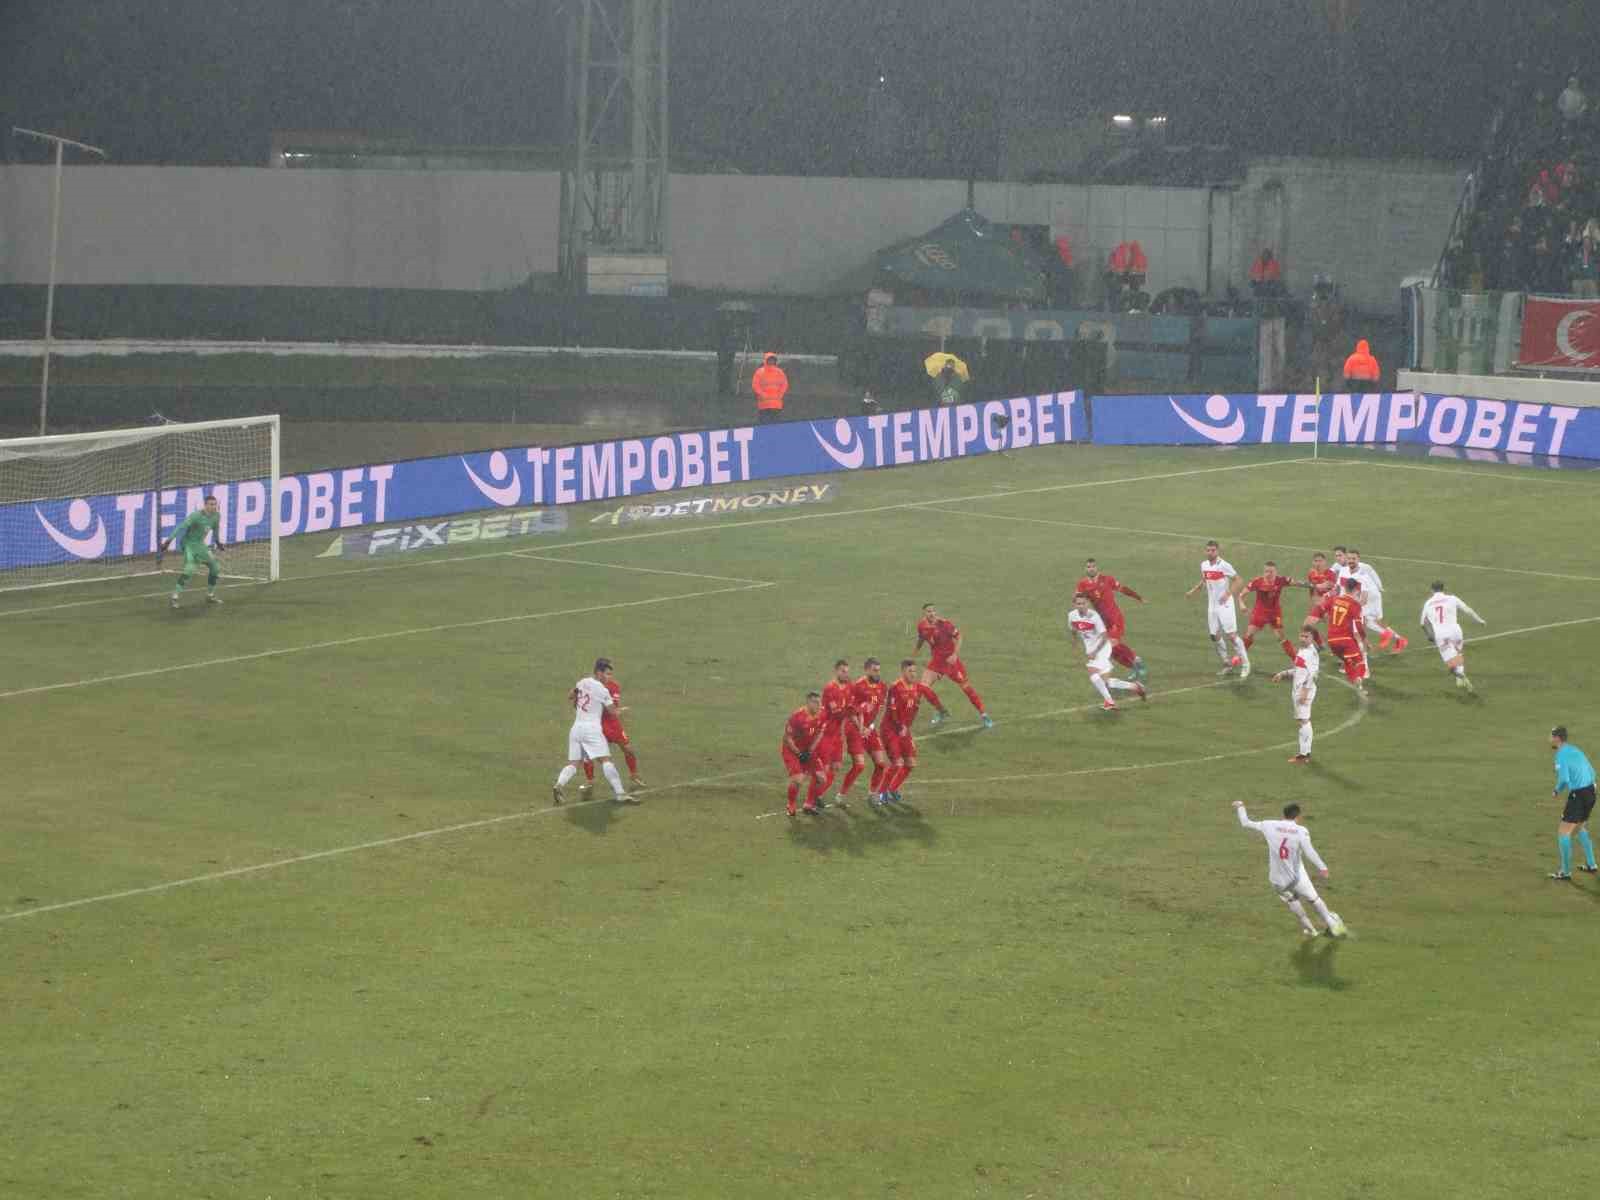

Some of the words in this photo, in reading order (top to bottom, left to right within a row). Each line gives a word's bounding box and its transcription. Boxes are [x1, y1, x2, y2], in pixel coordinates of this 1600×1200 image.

[868, 391, 1075, 465] TEMPOBET
[1257, 393, 1578, 456] TEMPOBET
[527, 428, 754, 504] TEMPOBET
[116, 465, 394, 555] TEMPOBET
[1333, 605, 1348, 627] 17
[1279, 837, 1290, 861] 6
